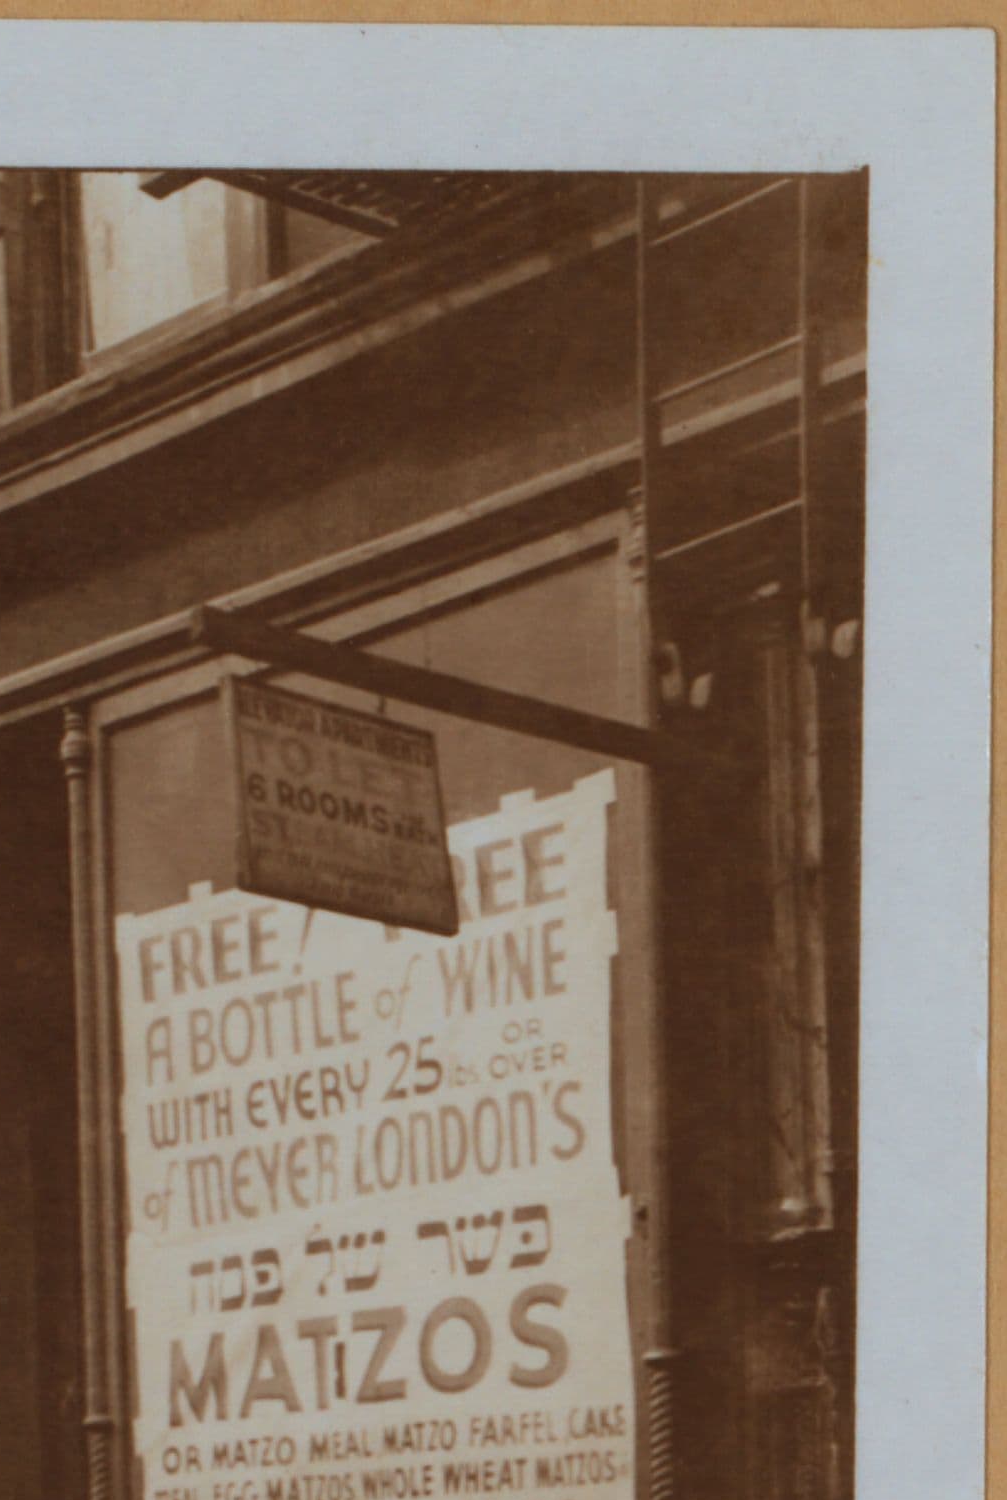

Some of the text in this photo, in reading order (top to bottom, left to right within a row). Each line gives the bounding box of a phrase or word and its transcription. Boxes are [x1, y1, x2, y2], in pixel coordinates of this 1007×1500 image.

[242, 728, 311, 776] TO
[247, 772, 266, 802] 6
[277, 779, 390, 834] ROOMS
[139, 906, 314, 1002] FREE!
[146, 918, 567, 1087] A BOTTLE of WINE
[501, 1017, 544, 1044] OR
[147, 1087, 234, 1151] WITH
[246, 1059, 370, 1129] EVERY
[384, 1035, 443, 1101] 25
[488, 1042, 569, 1080] OVER
[144, 1081, 586, 1231] of MEYER LONDON'S
[163, 1446, 203, 1475] OR
[212, 1436, 297, 1469] MATZO
[383, 1418, 458, 1454] MATZO
[567, 1403, 626, 1441] CAKE
[362, 1464, 434, 1500] WHOLE
[443, 1458, 528, 1495] WHEAT
